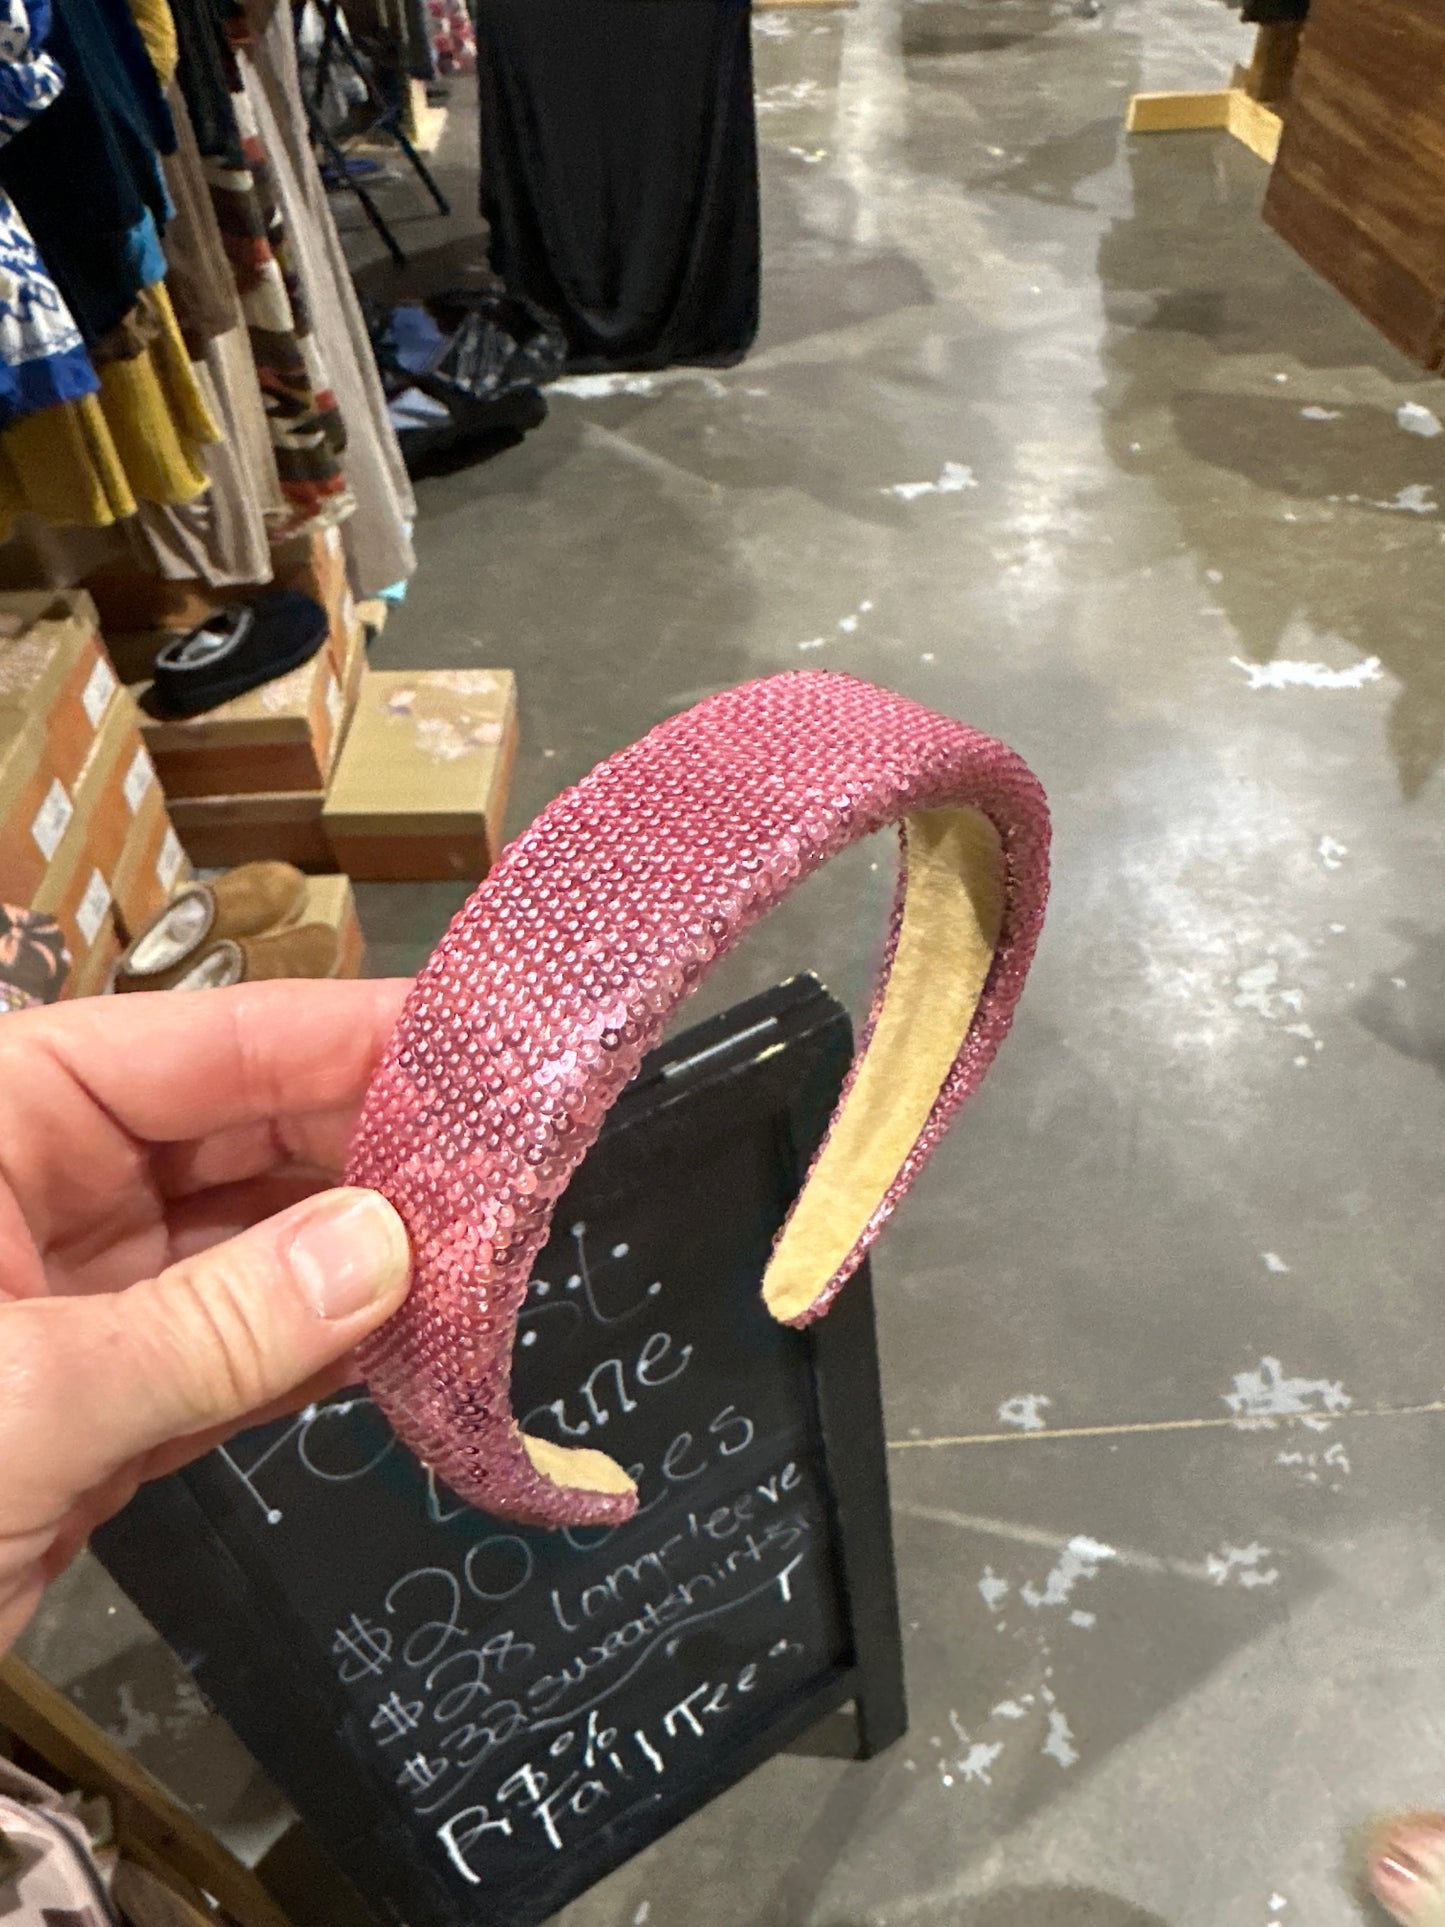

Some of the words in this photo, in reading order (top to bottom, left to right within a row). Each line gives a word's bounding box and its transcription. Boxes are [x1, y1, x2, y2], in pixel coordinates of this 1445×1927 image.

[332, 1534, 533, 1684] $20
[369, 1630, 536, 1746] $28
[396, 1699, 528, 1794] $32
